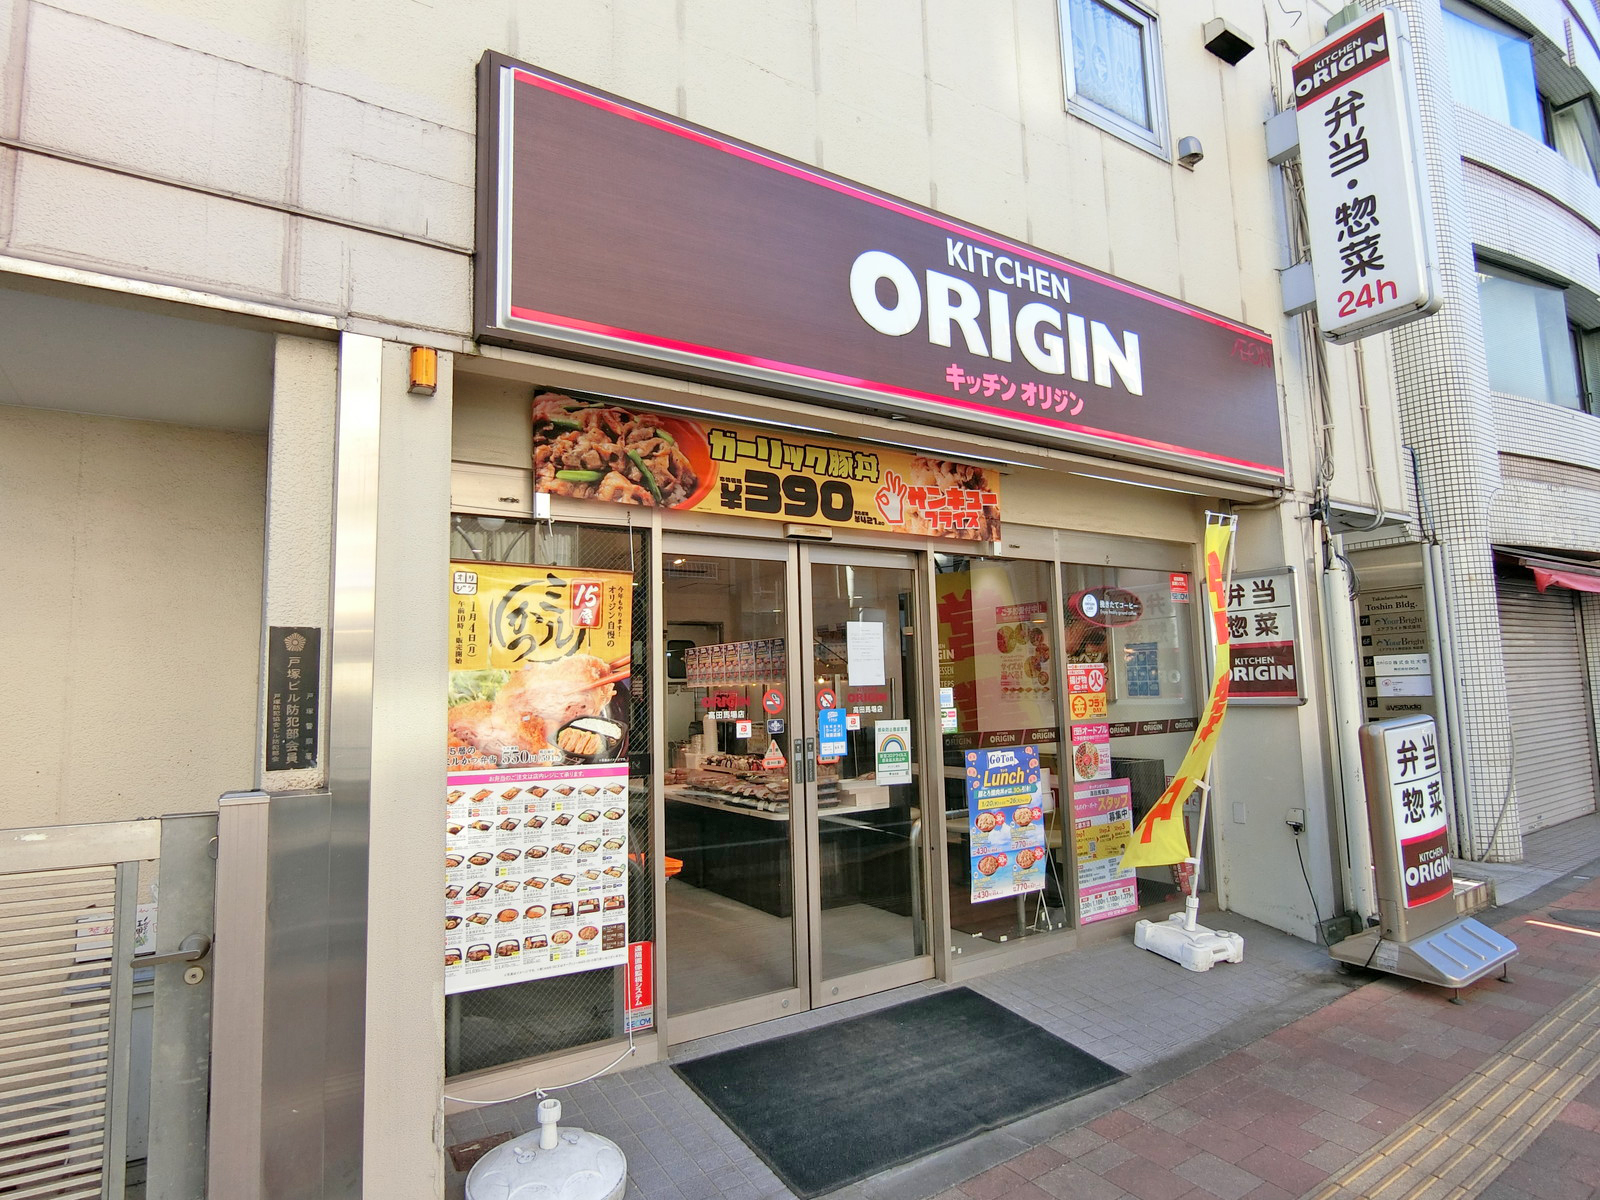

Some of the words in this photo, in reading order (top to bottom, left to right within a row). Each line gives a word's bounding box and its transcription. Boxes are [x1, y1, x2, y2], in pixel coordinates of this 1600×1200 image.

[1295, 34, 1386, 98] ORIGIN
[1314, 37, 1361, 71] KITCHEN
[1324, 90, 1385, 284] 弁当・惣菜
[946, 237, 1071, 304] KITCHEN
[1337, 279, 1398, 318] 24h
[849, 250, 1143, 397] ORIGIN
[945, 363, 1017, 401] キッチン
[1021, 382, 1085, 416] オリジン
[708, 428, 879, 484] ガーリック豚丼
[907, 486, 997, 511] サンキュー
[1224, 579, 1276, 607] 弁当
[1365, 603, 1393, 611] Toshin
[1396, 601, 1418, 609] Bldg.
[607, 586, 616, 647] オリジン自慢の
[1227, 612, 1279, 639] 惣菜
[1229, 665, 1295, 682] RIGIN
[1234, 656, 1275, 666] KITCHEN
[286, 657, 301, 764] 戸塚ビル防犯部会員
[990, 734, 1015, 743] ORIGIN
[1032, 732, 1055, 740] ORIGIN
[1110, 726, 1130, 734] ORIGIN
[1175, 721, 1193, 729] ORIGIN
[449, 746, 476, 755] 5層の
[1397, 733, 1436, 777] 弁当
[983, 767, 1025, 787] Lunch
[1098, 794, 1127, 811] スタッフ
[1109, 809, 1127, 821] 募集中
[1402, 780, 1443, 824] 惣菜
[1419, 845, 1443, 863] KITCHEN
[1406, 854, 1451, 886] ORIGIN
[627, 1017, 651, 1029] SECOM
